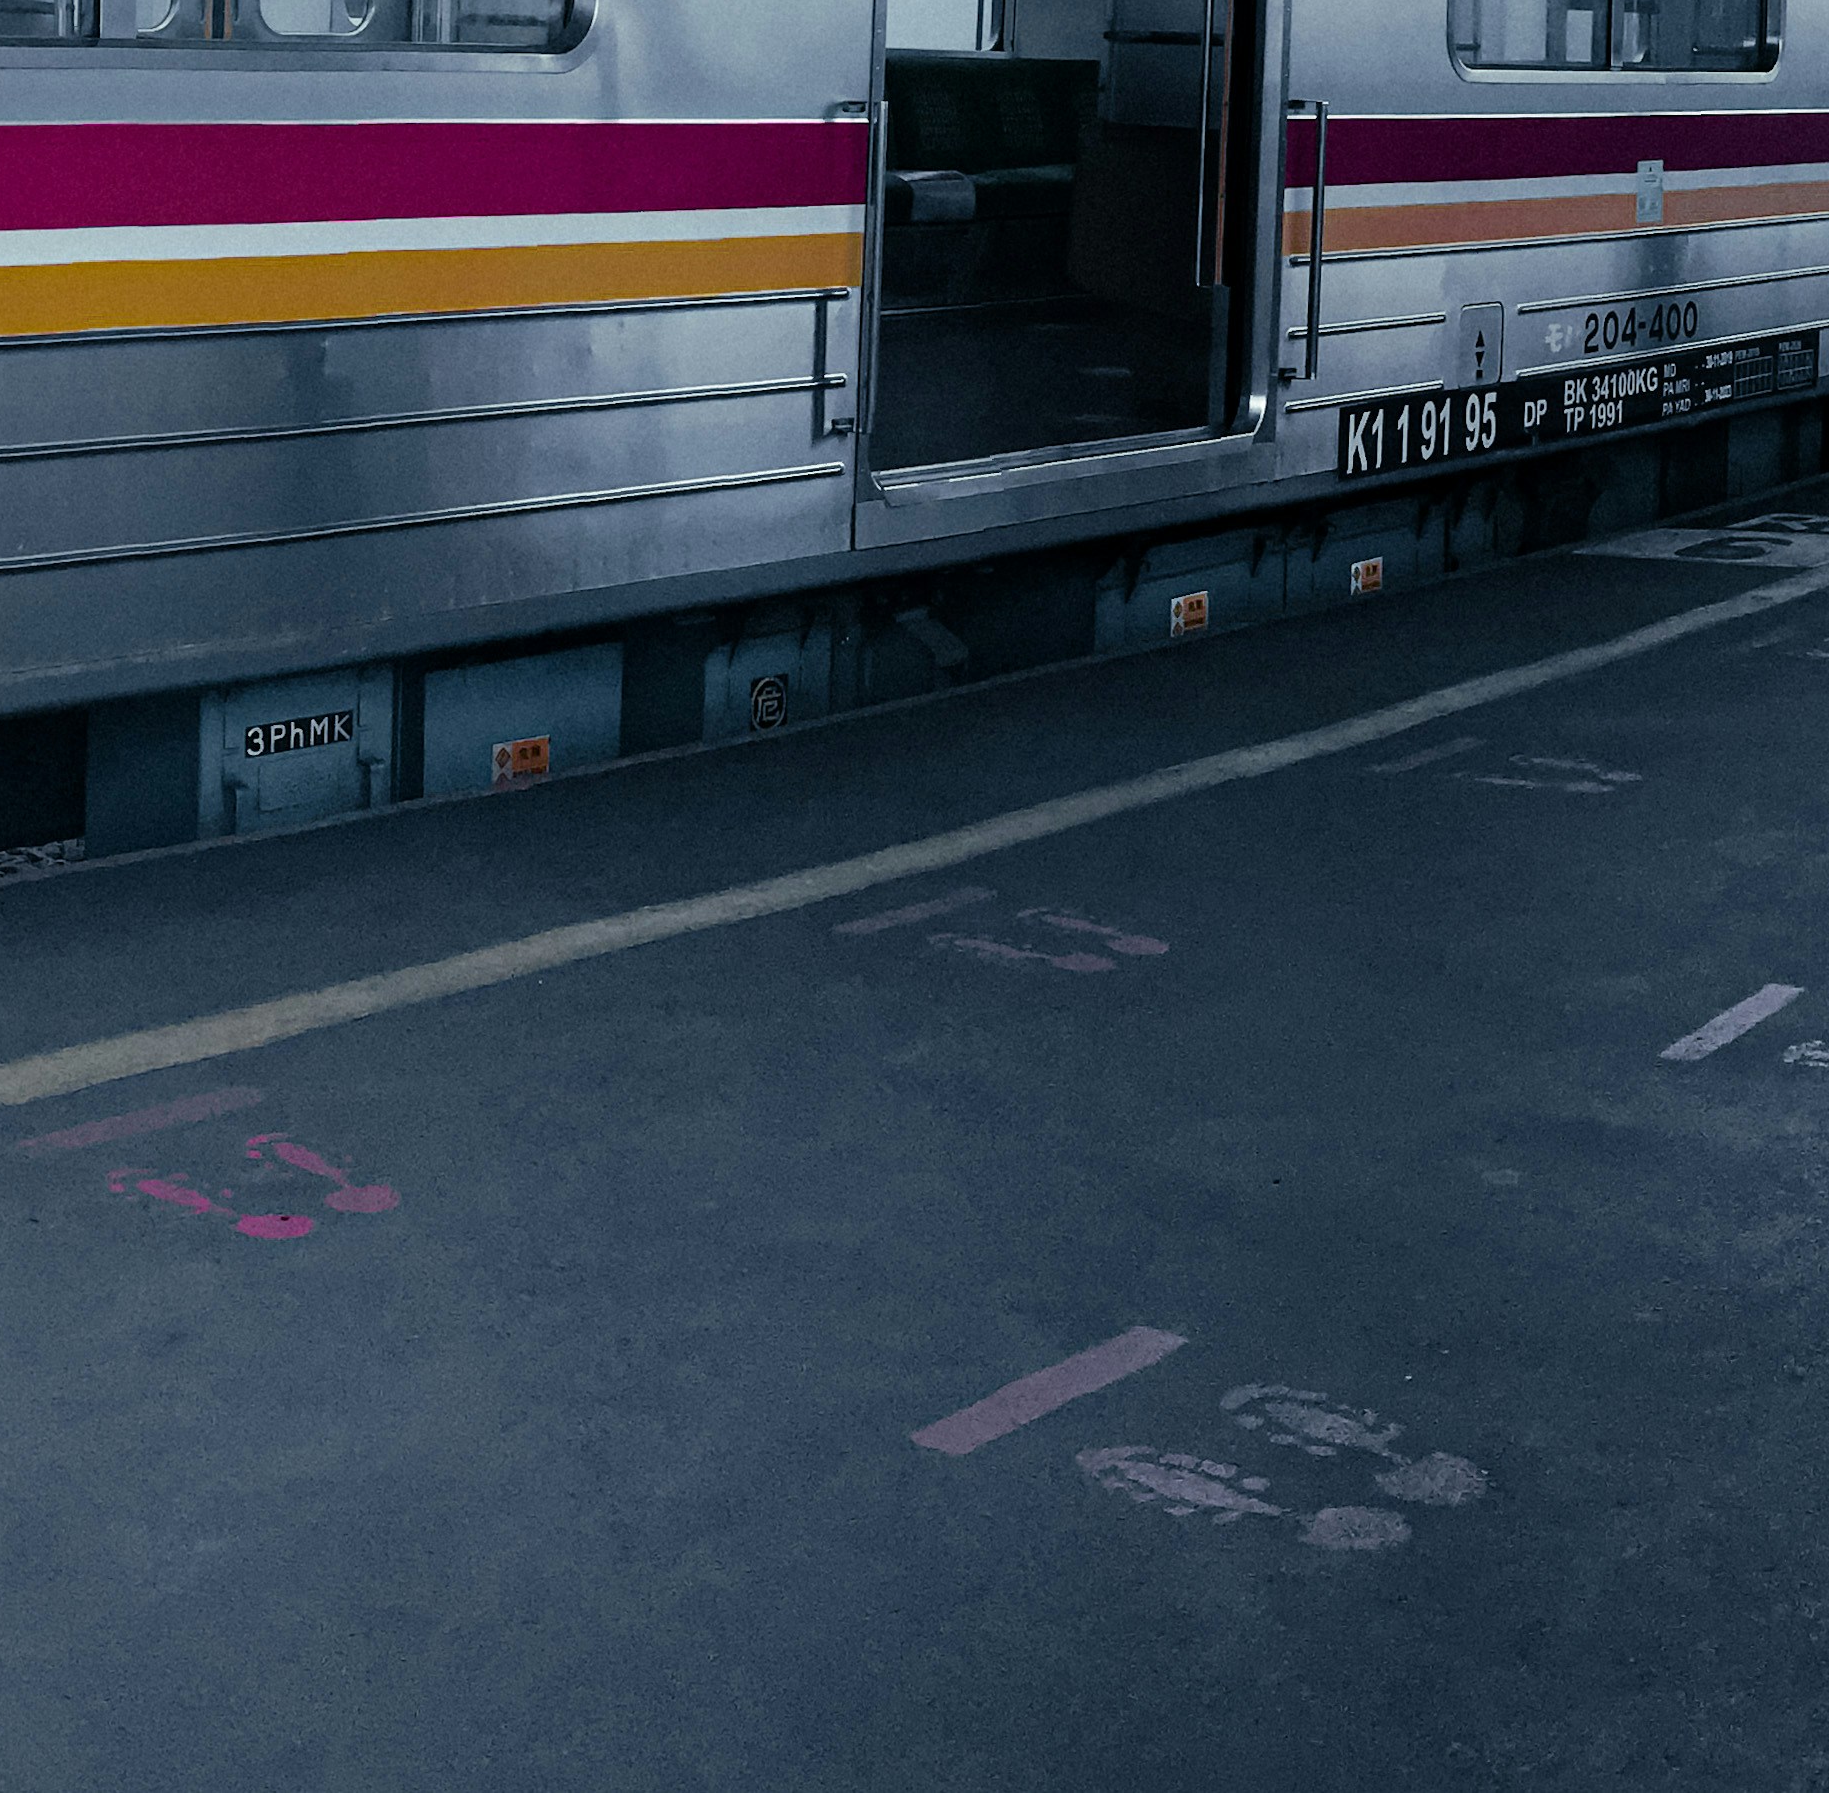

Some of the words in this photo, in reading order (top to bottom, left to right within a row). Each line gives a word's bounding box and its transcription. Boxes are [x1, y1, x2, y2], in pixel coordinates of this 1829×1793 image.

[1583, 300, 1699, 355] 204-400
[1563, 378, 1589, 405] BK
[1591, 368, 1659, 400] 34100KG
[1346, 407, 1385, 476] K1
[1420, 396, 1452, 461] 91
[1464, 391, 1497, 452] 95
[1523, 399, 1549, 429] DP
[1563, 408, 1587, 434] TP
[1589, 400, 1625, 429] 1991
[246, 712, 351, 757] 3PhMK
